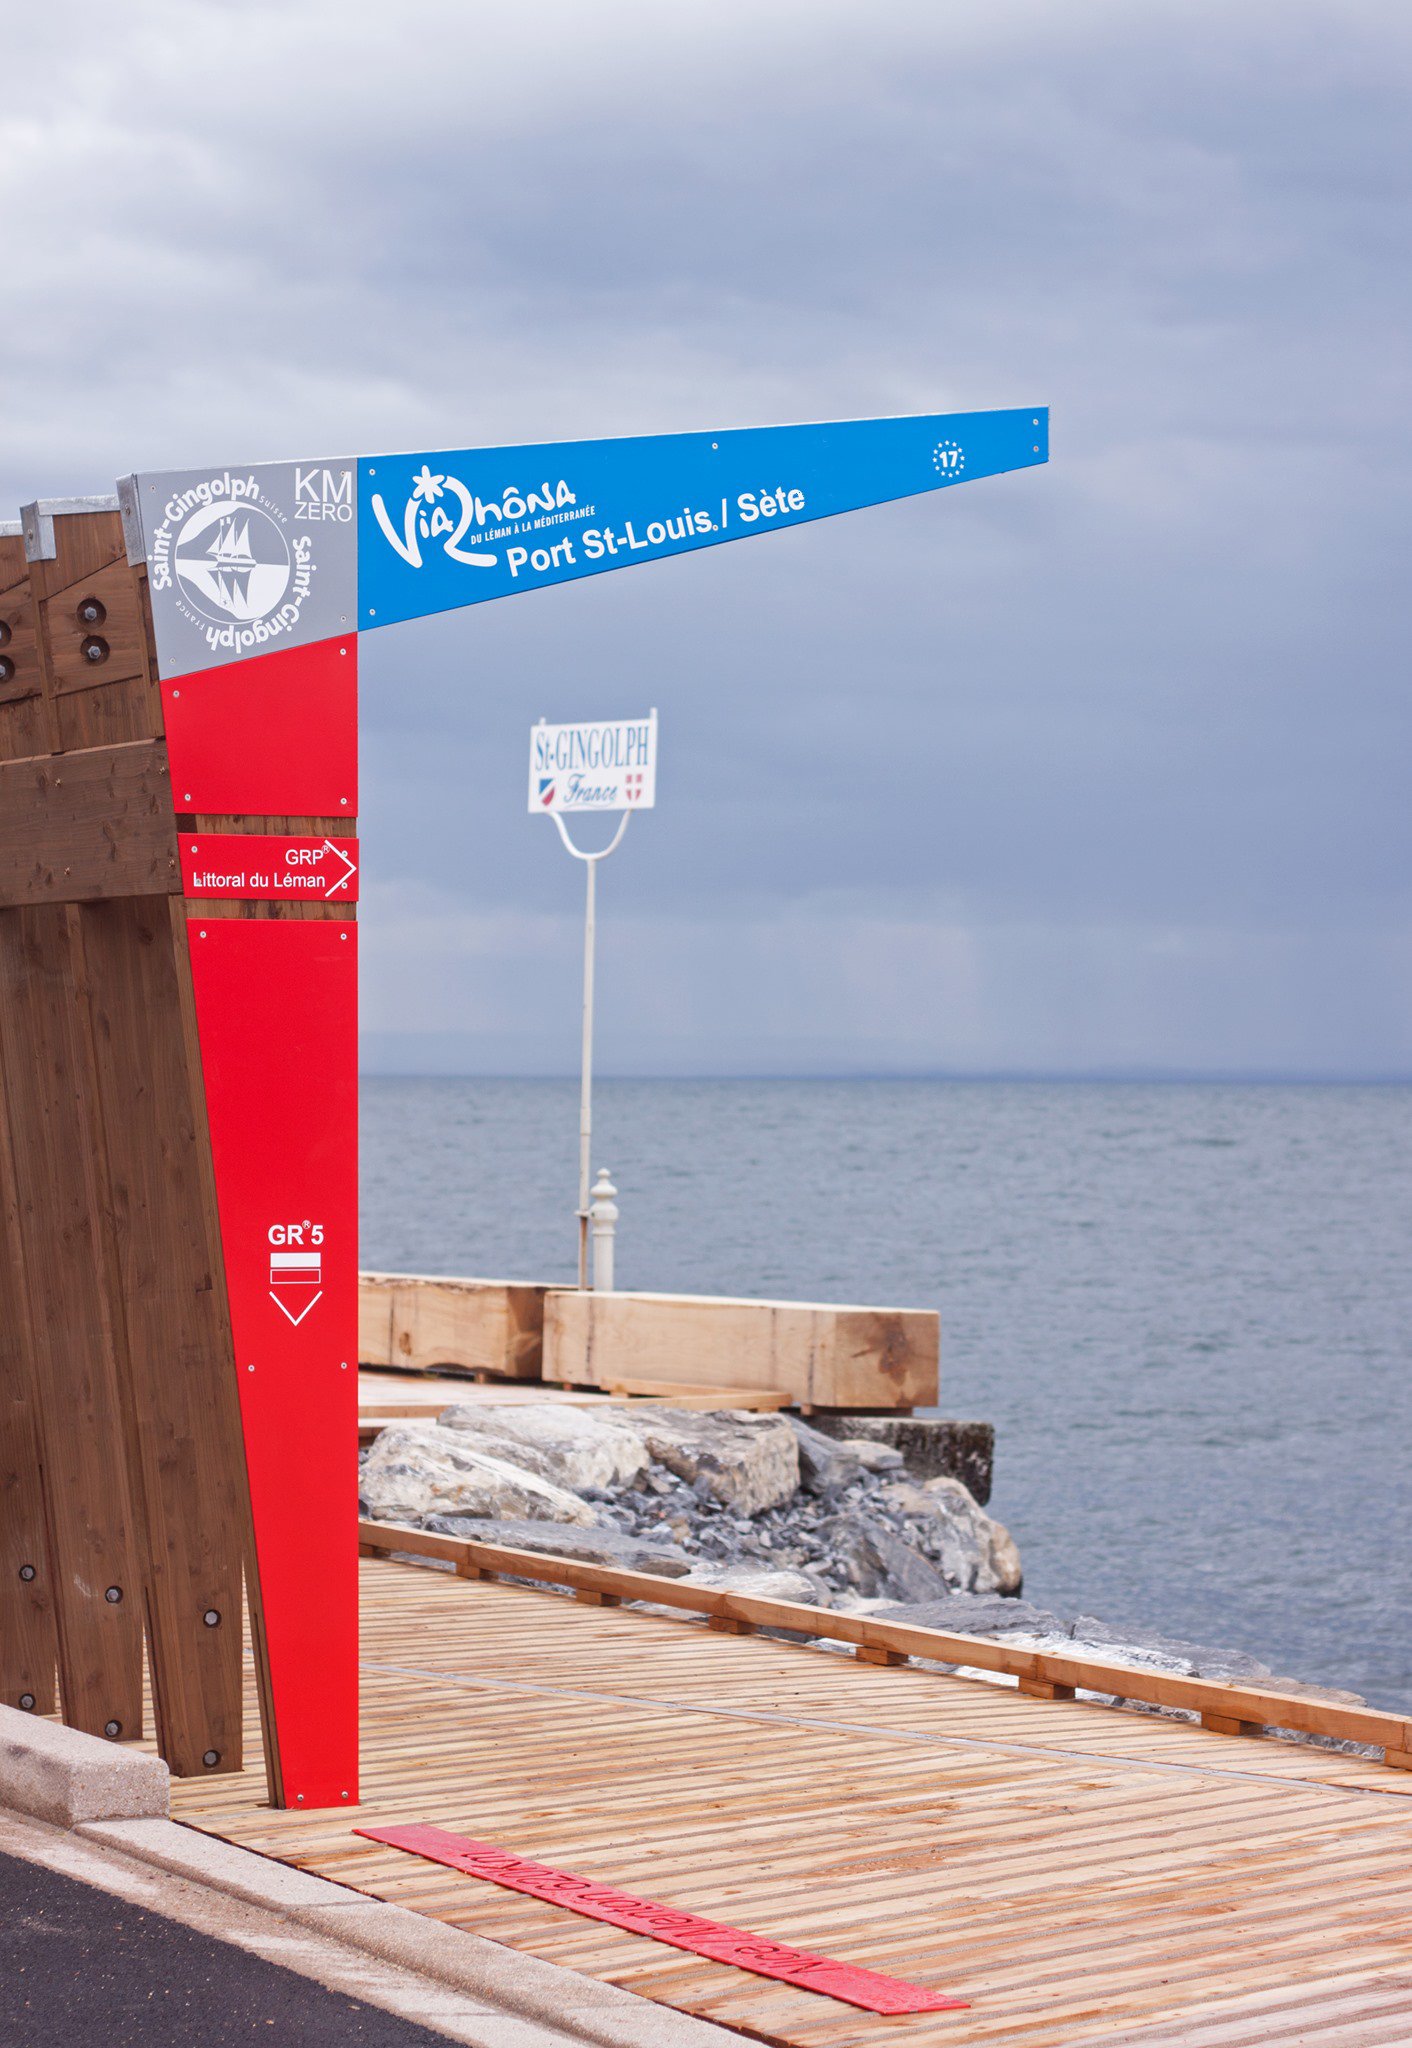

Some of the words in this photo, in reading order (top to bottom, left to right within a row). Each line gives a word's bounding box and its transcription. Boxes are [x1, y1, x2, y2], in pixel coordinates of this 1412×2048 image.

[939, 451, 958, 468] 17
[295, 468, 352, 504] KM
[294, 502, 353, 522] ZERO
[471, 534, 482, 545] DU
[485, 529, 512, 542] LÉMAN
[514, 521, 520, 534] À
[521, 523, 532, 533] LA
[534, 505, 596, 529] MÉDITERRANÉE
[147, 472, 260, 591] Saint-Gingolph
[506, 536, 576, 578] Port
[722, 498, 728, 528] /
[737, 486, 806, 523] Sète
[205, 535, 316, 654] Saint-Gingolph
[175, 600, 204, 631] France
[563, 773, 618, 803] France
[193, 872, 245, 888] Littoral
[250, 872, 269, 888] du
[274, 872, 326, 888] Léman
[577, 1891, 729, 1938] Menton
[734, 1945, 845, 1974] Nice
